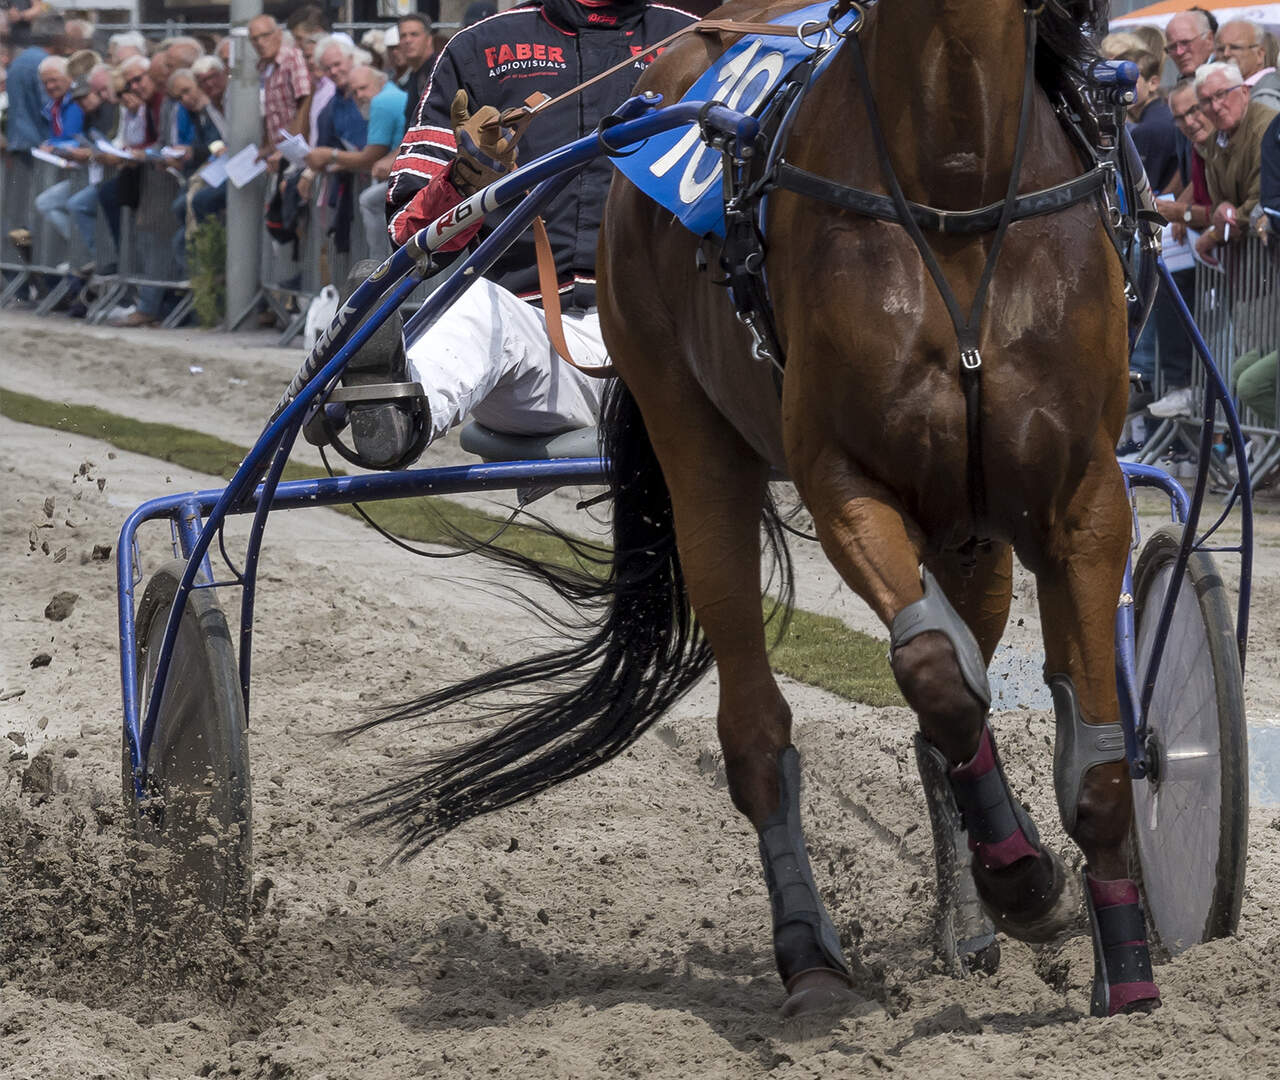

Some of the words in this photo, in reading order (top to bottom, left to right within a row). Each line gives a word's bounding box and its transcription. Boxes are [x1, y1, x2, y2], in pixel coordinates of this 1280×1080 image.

[484, 42, 566, 69] FABER
[488, 61, 568, 78] AUDIOVISUALS
[649, 38, 785, 205] 10
